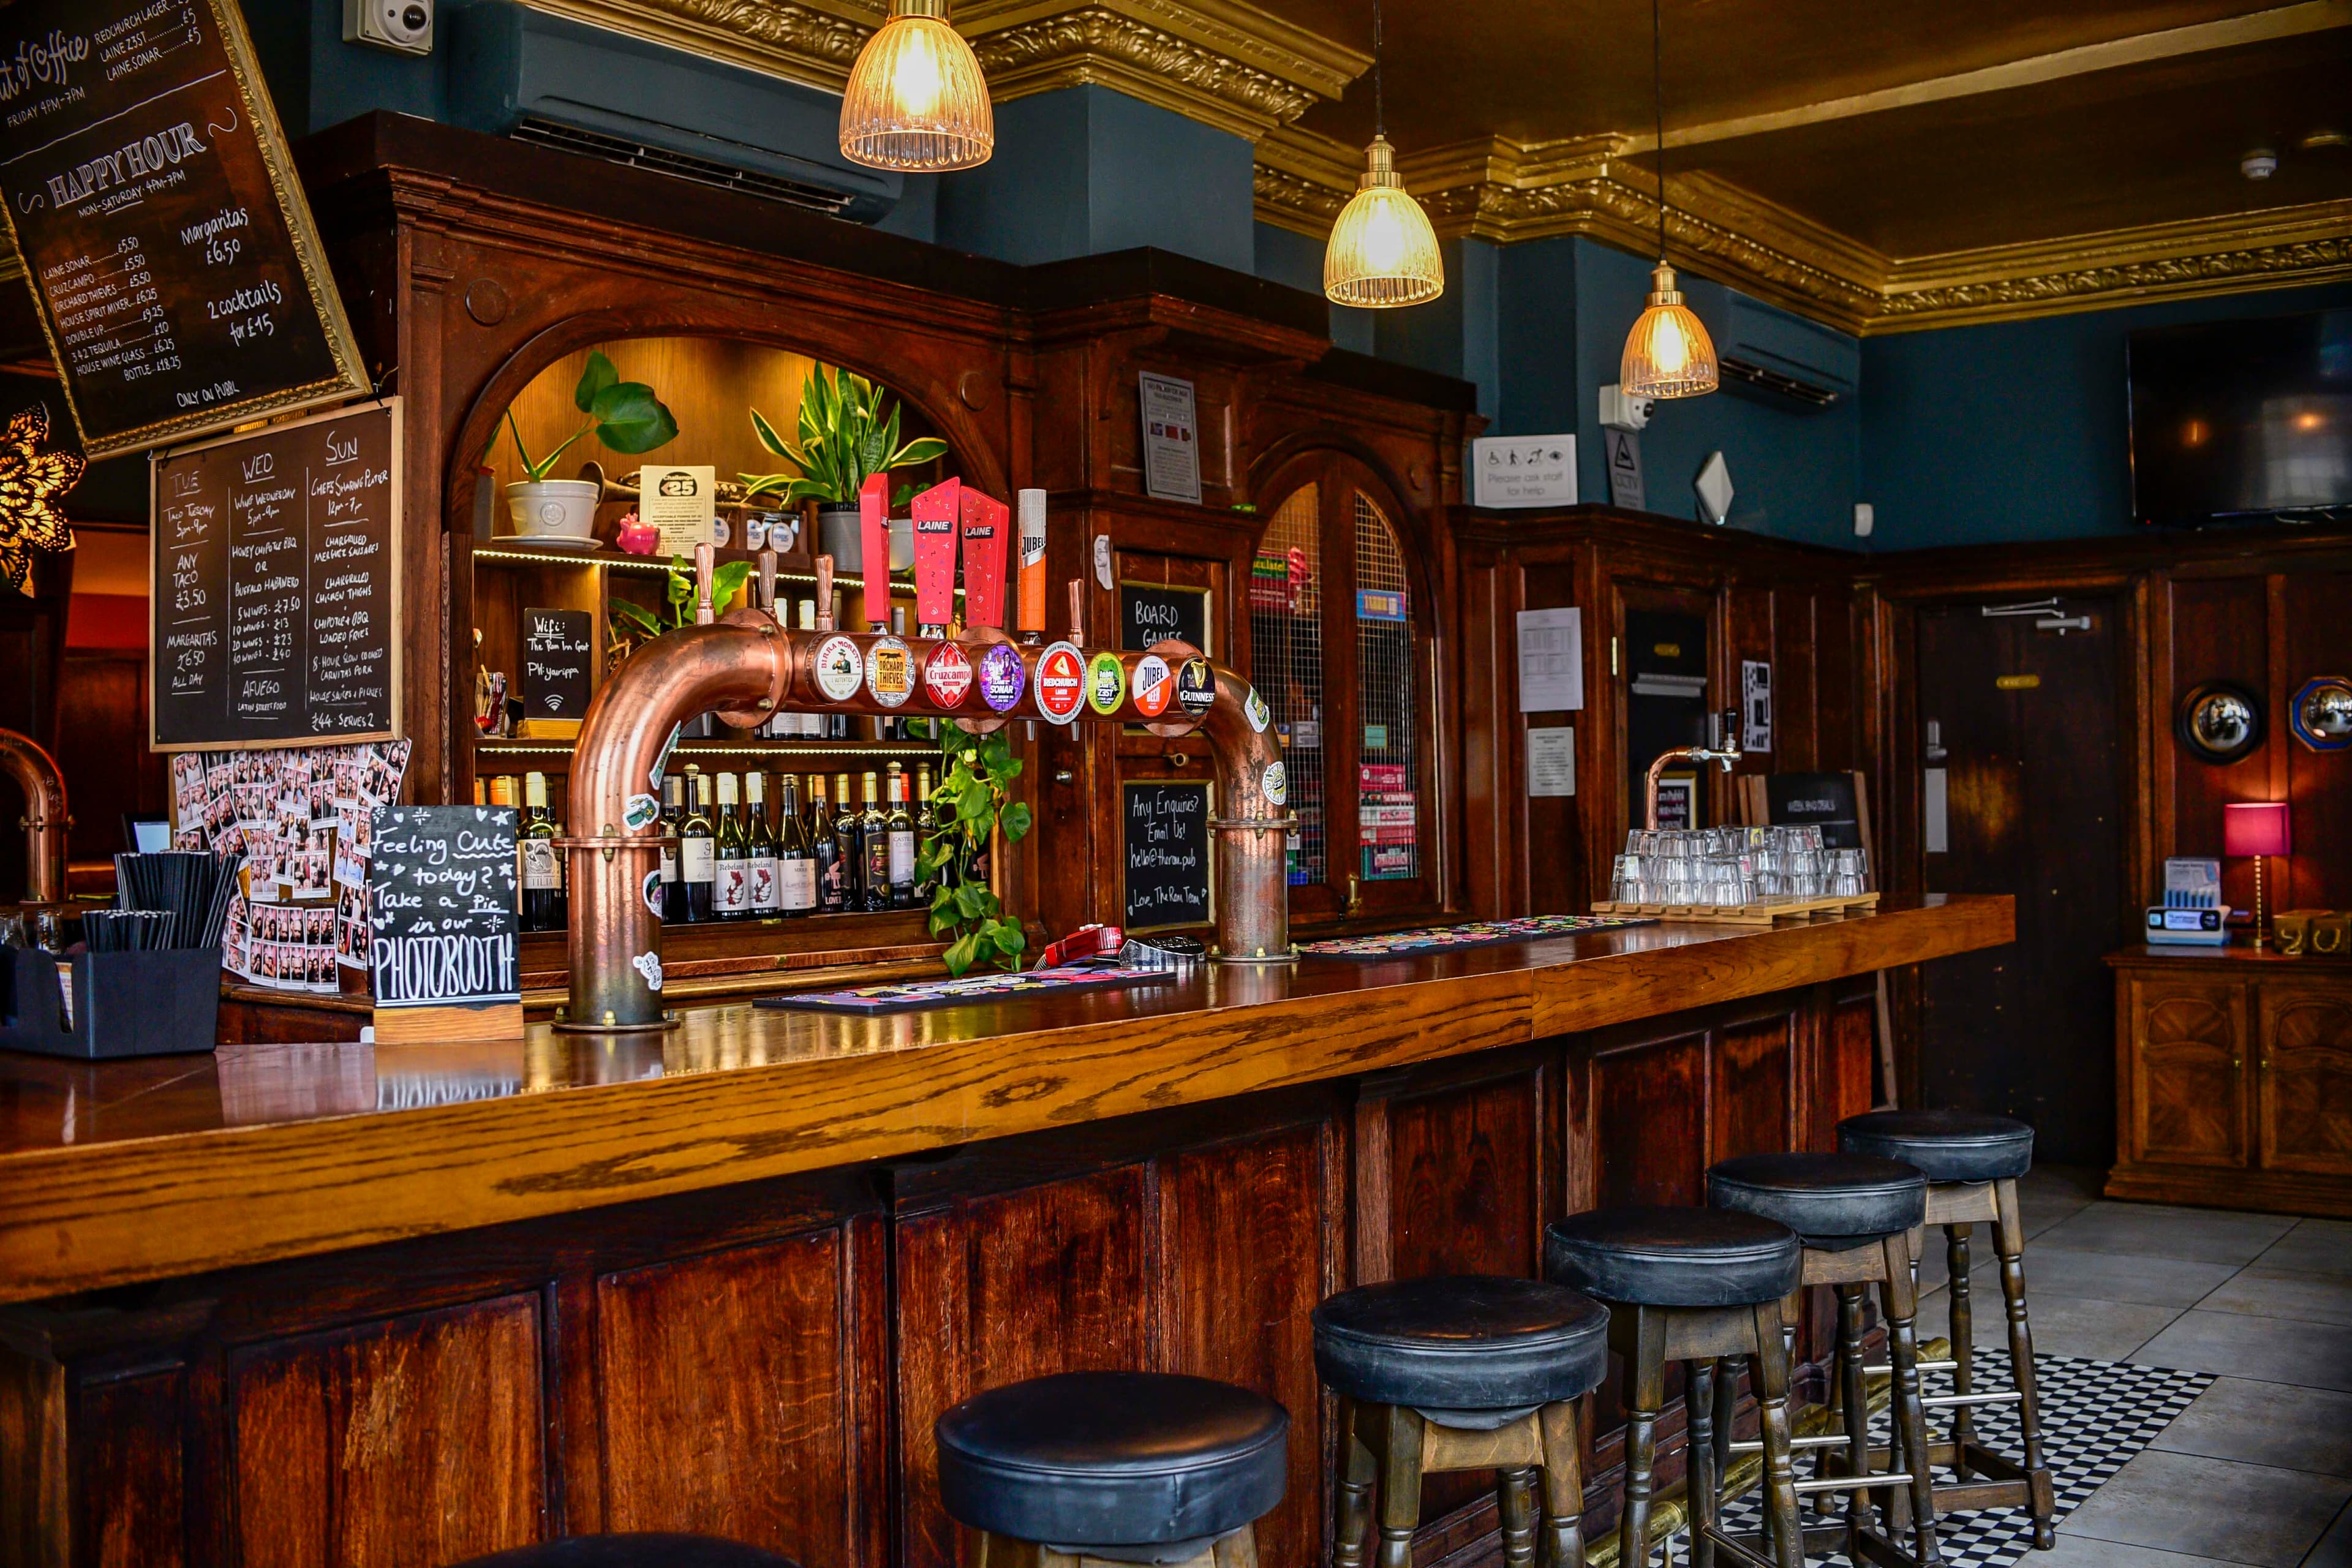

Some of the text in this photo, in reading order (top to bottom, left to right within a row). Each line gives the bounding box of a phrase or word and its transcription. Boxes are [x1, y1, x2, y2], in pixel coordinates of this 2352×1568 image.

[94, 0, 171, 45] REDCHURCH LAGER
[100, 8, 196, 62] LAINE Z3ST £5
[15, 29, 89, 89] of Office
[106, 27, 202, 81] LAINE SONAR £5
[7, 86, 86, 127] FRIDAY 4PM-7PM
[47, 123, 208, 209] HAPPY HOUR
[78, 169, 186, 218] MON-SATURDAY 4PM-7PM
[181, 207, 249, 245] Margaritas
[43, 236, 139, 279] LAINE SONAR £5.50
[207, 239, 241, 265] £6.50
[49, 254, 145, 298] CRUZCAMPO £5.50
[55, 271, 151, 312] ORCHARD THIEVES £5.50
[208, 279, 282, 320] 2 cocktails
[60, 288, 157, 329] HOUSE SPIRIT MIXER £6.25
[65, 328, 94, 345] DOUBLE
[94, 324, 105, 336] UP
[88, 321, 169, 355] TEQUILA £10
[230, 313, 274, 347] for £15
[76, 360, 102, 377] HOUSE
[100, 353, 123, 368] WINE
[121, 348, 146, 364] GLASS
[123, 355, 182, 382] BOTTLE £18.25
[176, 391, 199, 407] ONLY
[202, 388, 214, 401] ON
[325, 431, 358, 461] SUN
[243, 453, 274, 481] WED
[170, 470, 201, 492] TUE
[669, 481, 694, 496] 25
[1487, 473, 1521, 484] Please
[1524, 472, 1540, 481] ask
[1506, 486, 1545, 497] for help
[918, 521, 949, 530] LAINE
[965, 527, 992, 537] LAINE
[232, 545, 254, 559] HONEY
[1022, 536, 1044, 556] JUBEL
[177, 552, 199, 571] ANY
[255, 561, 268, 573] OR
[173, 570, 198, 588] TACO
[235, 582, 263, 597] BUFFALO
[176, 589, 206, 611] £3.50
[347, 584, 372, 600] THIGHS
[238, 607, 243, 621] 5
[274, 596, 301, 614] £7.50
[1136, 600, 1178, 627] BOARD
[233, 617, 290, 636] 10 WINGS £13
[319, 627, 369, 644] LOADED FRIES
[167, 630, 217, 649] MARGARITAS
[232, 633, 292, 652] 20 WINGS £23
[527, 638, 543, 651] The
[271, 648, 292, 661] £40
[821, 641, 861, 669] BIRRA MORETTI
[320, 665, 373, 681] CARNITAS PORK
[879, 660, 903, 672] ORCHARD
[172, 673, 204, 688] ALL DAY
[879, 671, 903, 684] THIEVES
[1043, 677, 1078, 687] REDCHURCH
[1143, 666, 1164, 691] JUBEL
[242, 680, 280, 698] AFUEGO
[990, 685, 1014, 694] SONAR
[1181, 690, 1215, 703] GUINNESS
[238, 703, 255, 712] LATIN
[273, 702, 287, 710] FOOD
[311, 712, 375, 732] £44 SERVES 2
[1133, 794, 1152, 827] Any
[1148, 820, 1186, 843] Email Us!
[371, 827, 515, 865] Feeling Cute
[372, 881, 500, 911] Take a Pic
[1154, 886, 1169, 905] The
[1183, 886, 1201, 905] Team
[408, 916, 473, 933] in our
[373, 933, 515, 1000] PHOTOBOOTH
